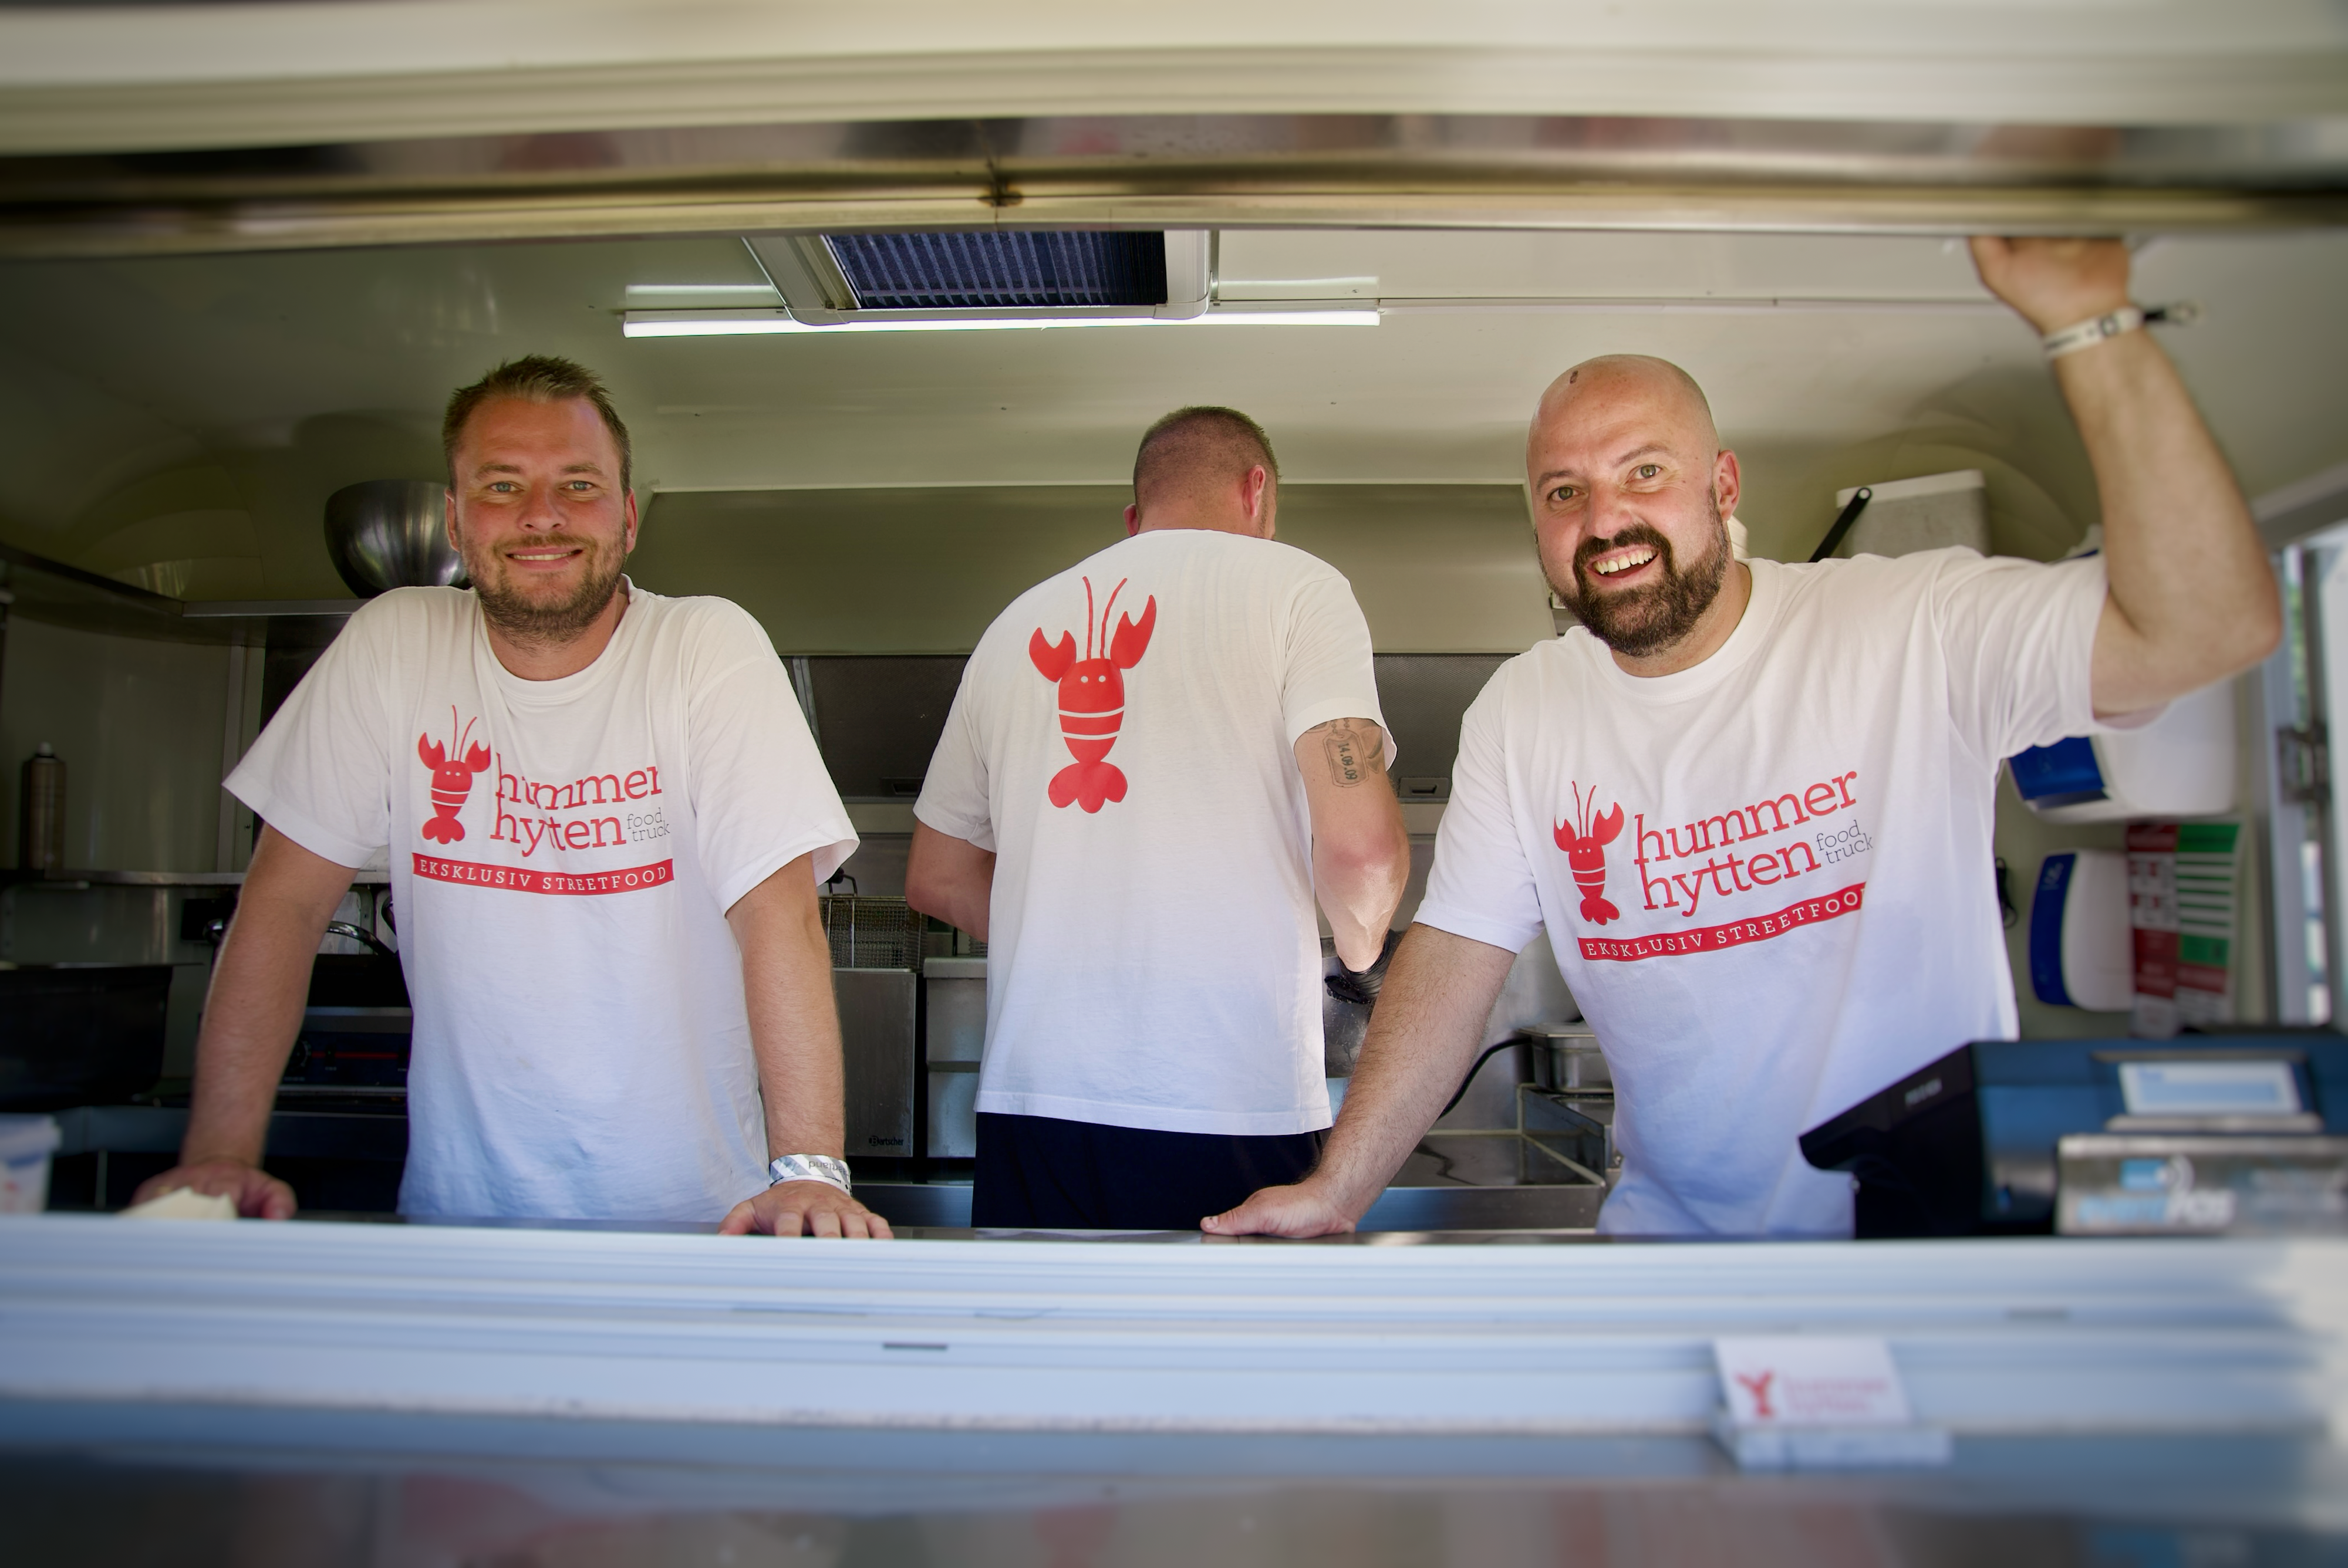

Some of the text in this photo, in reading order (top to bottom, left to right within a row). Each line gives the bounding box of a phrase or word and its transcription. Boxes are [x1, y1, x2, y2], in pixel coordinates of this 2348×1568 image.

[626, 807, 663, 829] food
[632, 820, 670, 842] truck
[1634, 771, 1857, 864] hummer
[1816, 819, 1861, 851] food
[1826, 833, 1874, 864] truck
[420, 859, 667, 891] EKSKLUSIV STREETFOOD
[1634, 841, 1821, 917] hytten
[1586, 933, 1703, 957] EKSKLUSIV
[868, 1135, 905, 1147] Bartscher
